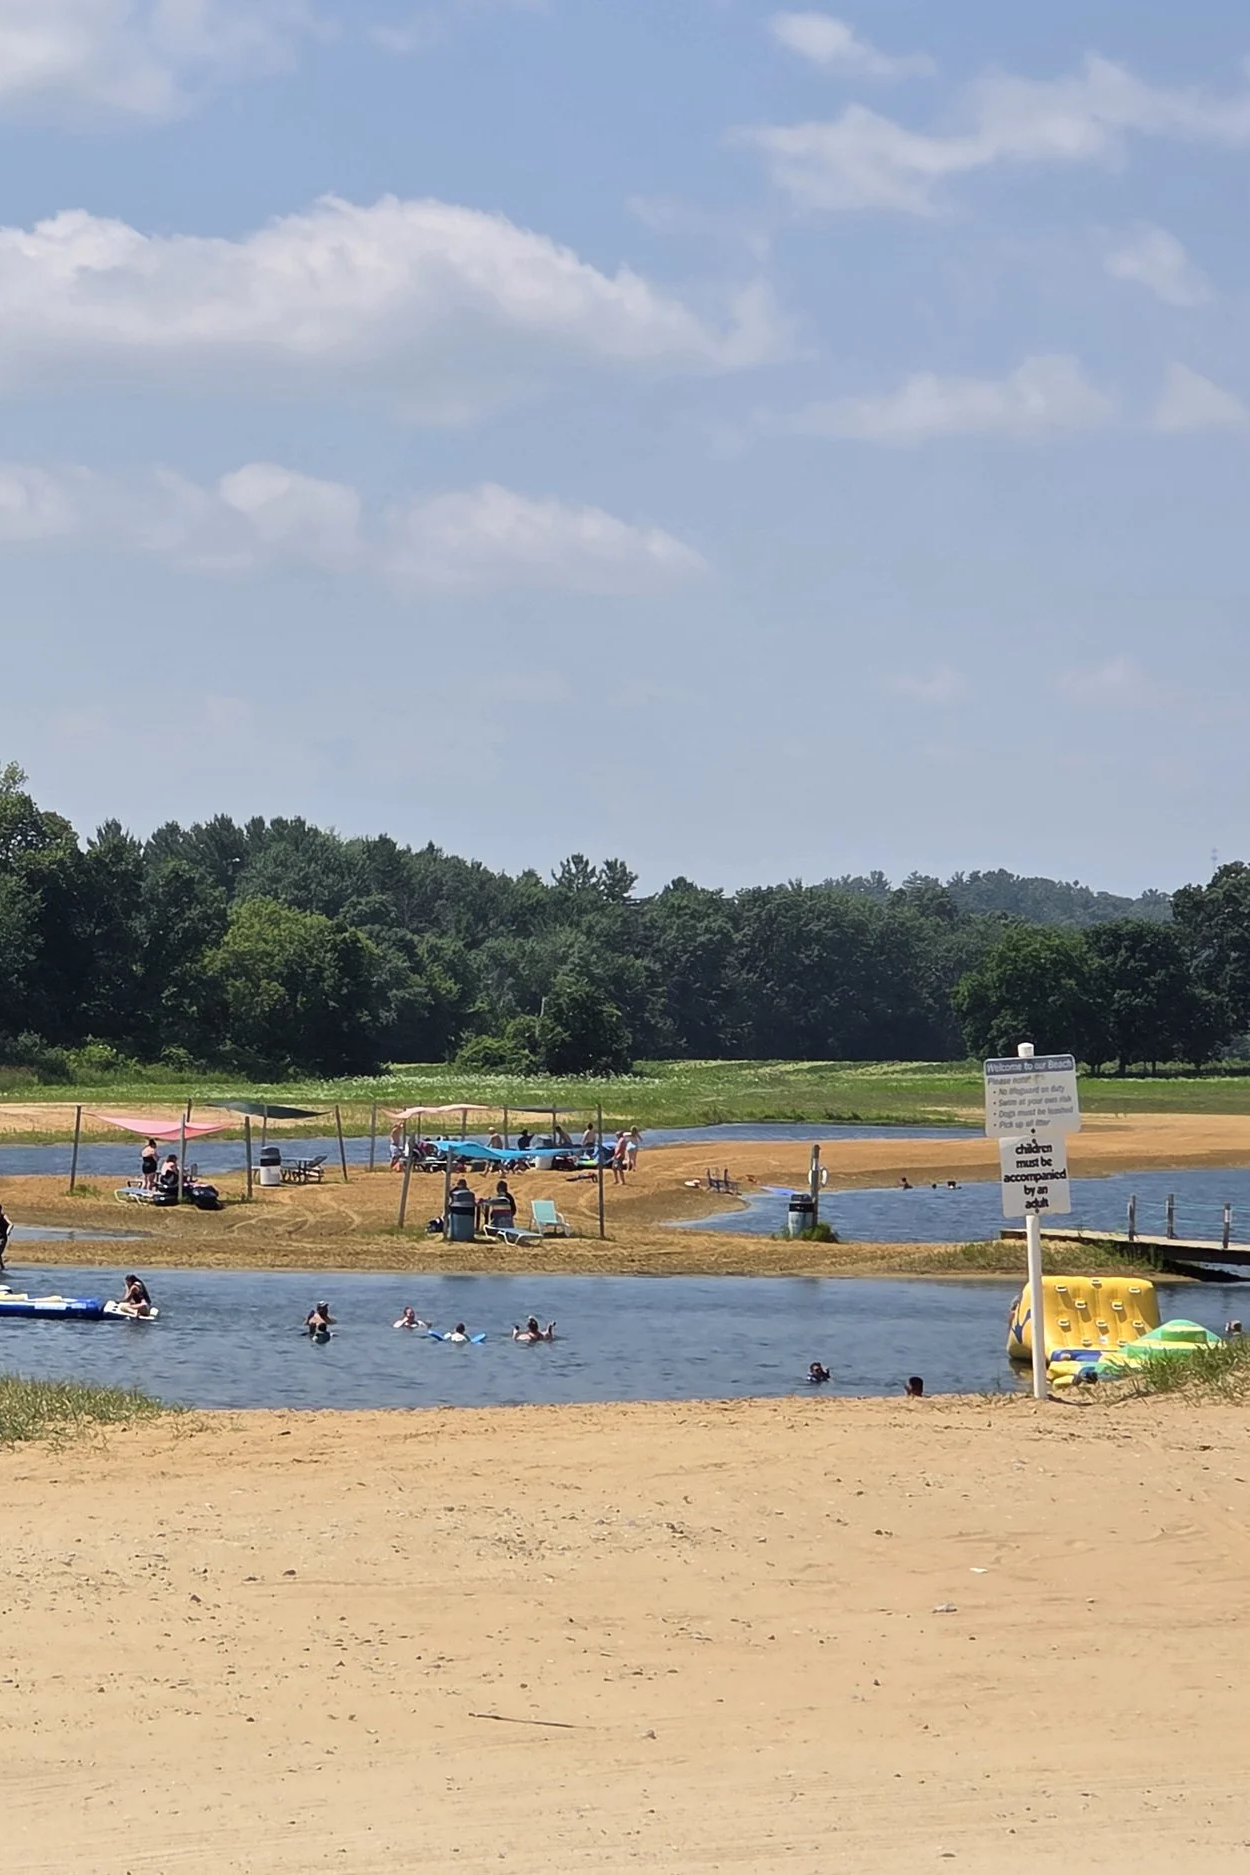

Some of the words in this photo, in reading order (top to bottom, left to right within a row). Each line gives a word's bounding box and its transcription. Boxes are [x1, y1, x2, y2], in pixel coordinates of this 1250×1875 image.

[987, 1062, 1022, 1072] Welcome
[1024, 1061, 1033, 1070] to
[1048, 1059, 1072, 1069] Beach
[1015, 1143, 1053, 1155] children
[1016, 1158, 1040, 1169] must
[1041, 1156, 1053, 1167] be
[1003, 1168, 1067, 1183] accompanied
[1024, 1185, 1035, 1197] by
[1037, 1186, 1048, 1195] an
[1025, 1197, 1049, 1210] adult
